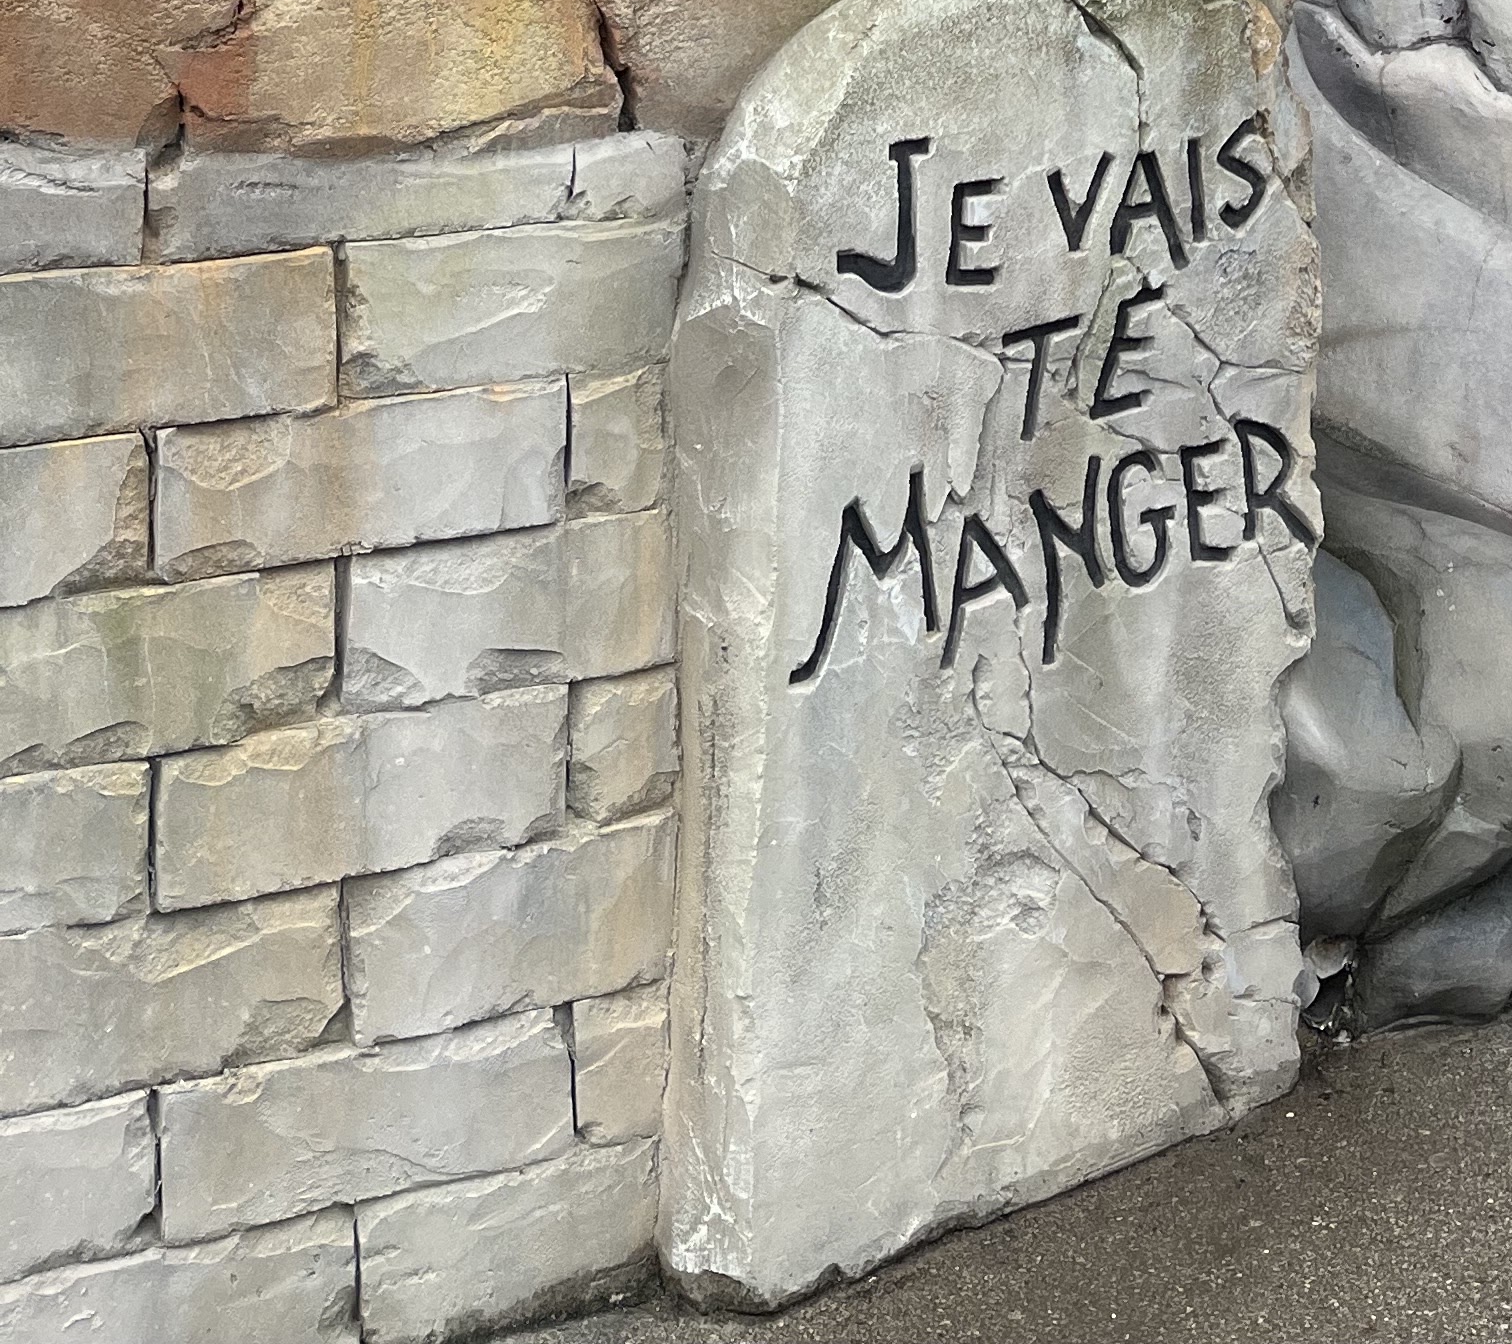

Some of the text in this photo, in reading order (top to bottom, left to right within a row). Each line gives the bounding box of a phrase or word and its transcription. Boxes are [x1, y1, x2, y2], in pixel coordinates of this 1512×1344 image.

[836, 110, 1275, 293] JE VAIS
[1002, 285, 1166, 441] TE
[789, 418, 1316, 686] MANGER
